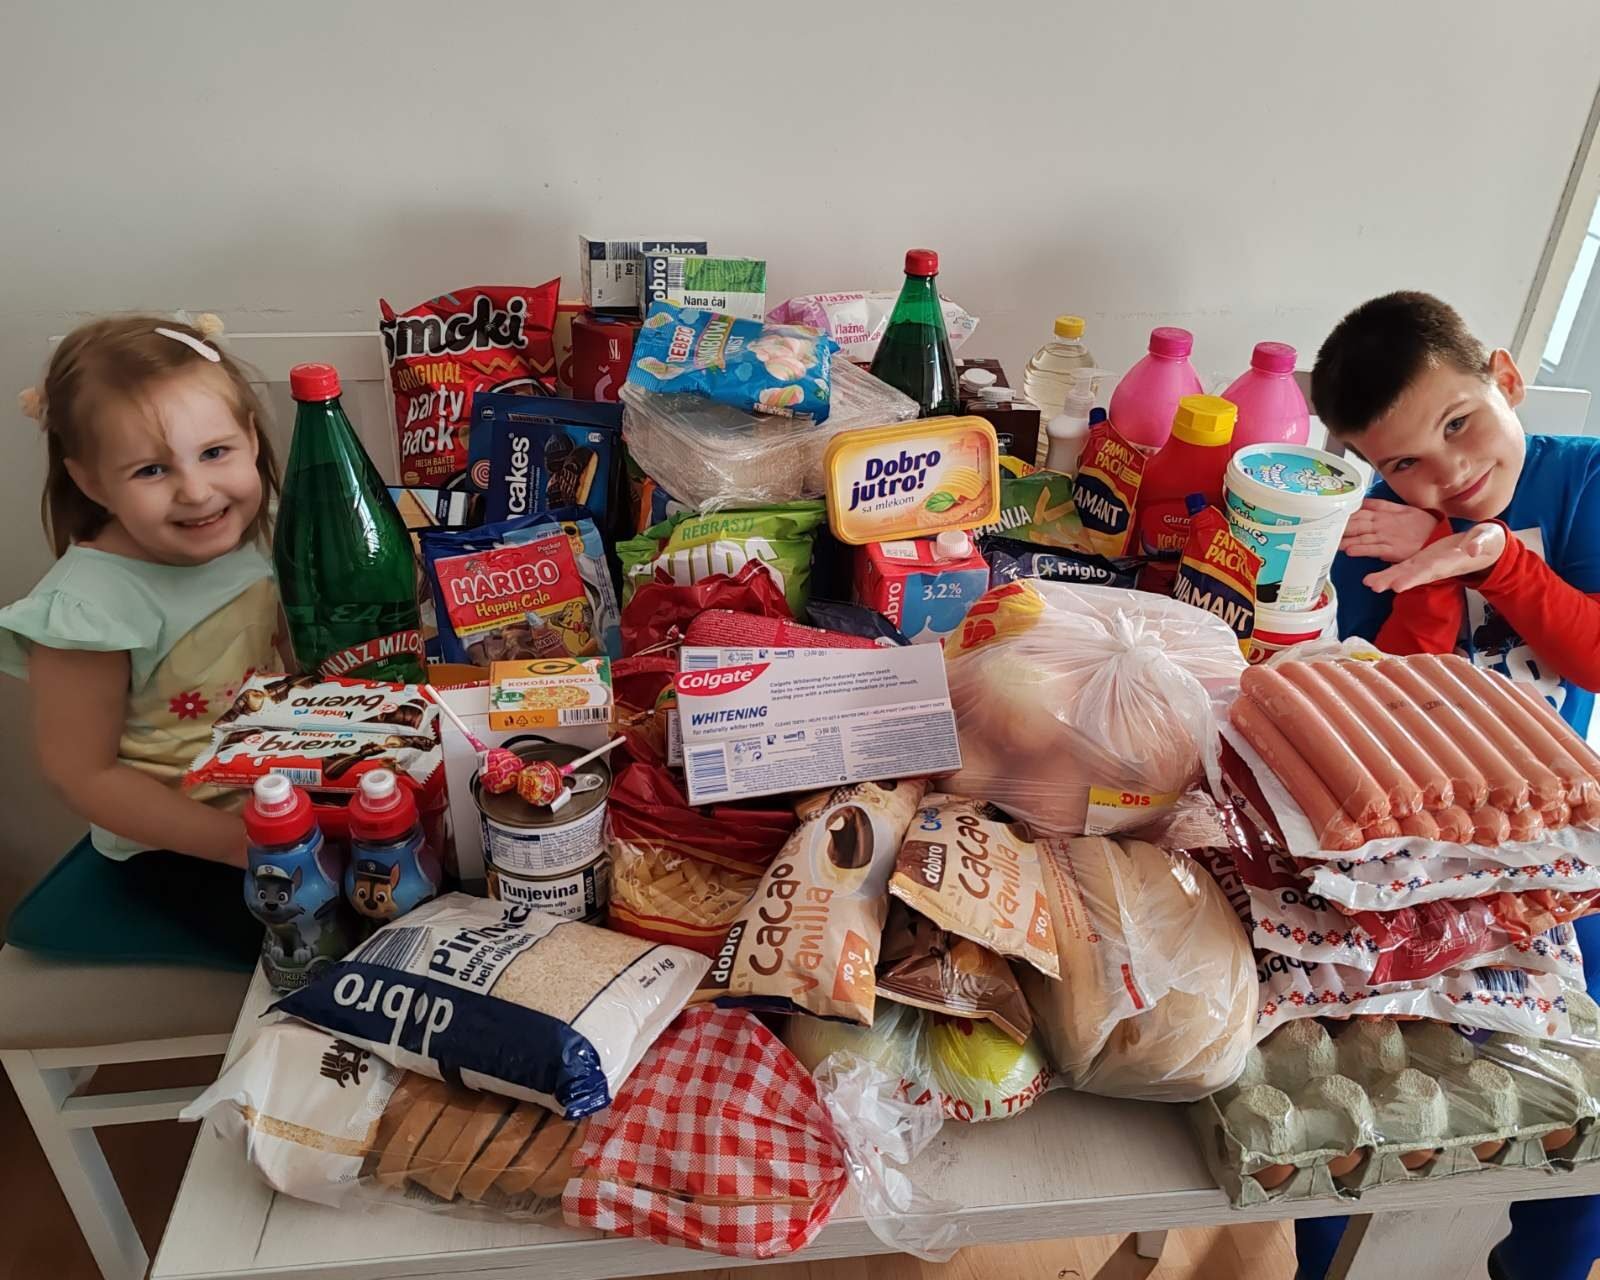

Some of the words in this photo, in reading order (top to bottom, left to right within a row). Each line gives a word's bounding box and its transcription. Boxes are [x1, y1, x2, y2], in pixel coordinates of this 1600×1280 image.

[652, 258, 667, 302] obro
[684, 296, 708, 307] Nana
[711, 296, 726, 308] čaj
[398, 362, 464, 391] ORIGINAL
[405, 384, 464, 428] party
[402, 418, 454, 464] pack
[415, 456, 432, 468] FRESH
[433, 456, 455, 466] BAKED
[426, 464, 456, 475] PEANUTS
[865, 450, 941, 482] Dobro
[506, 436, 530, 521] cakes
[848, 469, 926, 512] jutro!
[862, 505, 872, 514] sa
[876, 494, 914, 510] mlekom
[1074, 485, 1123, 527] AMANT
[1057, 560, 1108, 578] Friglo
[452, 560, 560, 606] HARIBO
[888, 582, 902, 625] obro
[558, 676, 594, 686] KOCKA
[678, 669, 753, 690] Colgate
[291, 694, 385, 712] bueno
[690, 706, 768, 726] WHITENING
[258, 734, 356, 752] bueno
[1120, 792, 1150, 806] DIS
[926, 844, 944, 886] dobro
[500, 880, 578, 902] Tunjevina
[458, 946, 490, 985] dugog
[713, 925, 743, 984] dobro
[472, 961, 496, 988] beli
[654, 964, 661, 978] 1
[660, 956, 676, 973] kg
[984, 1100, 992, 1117] I
